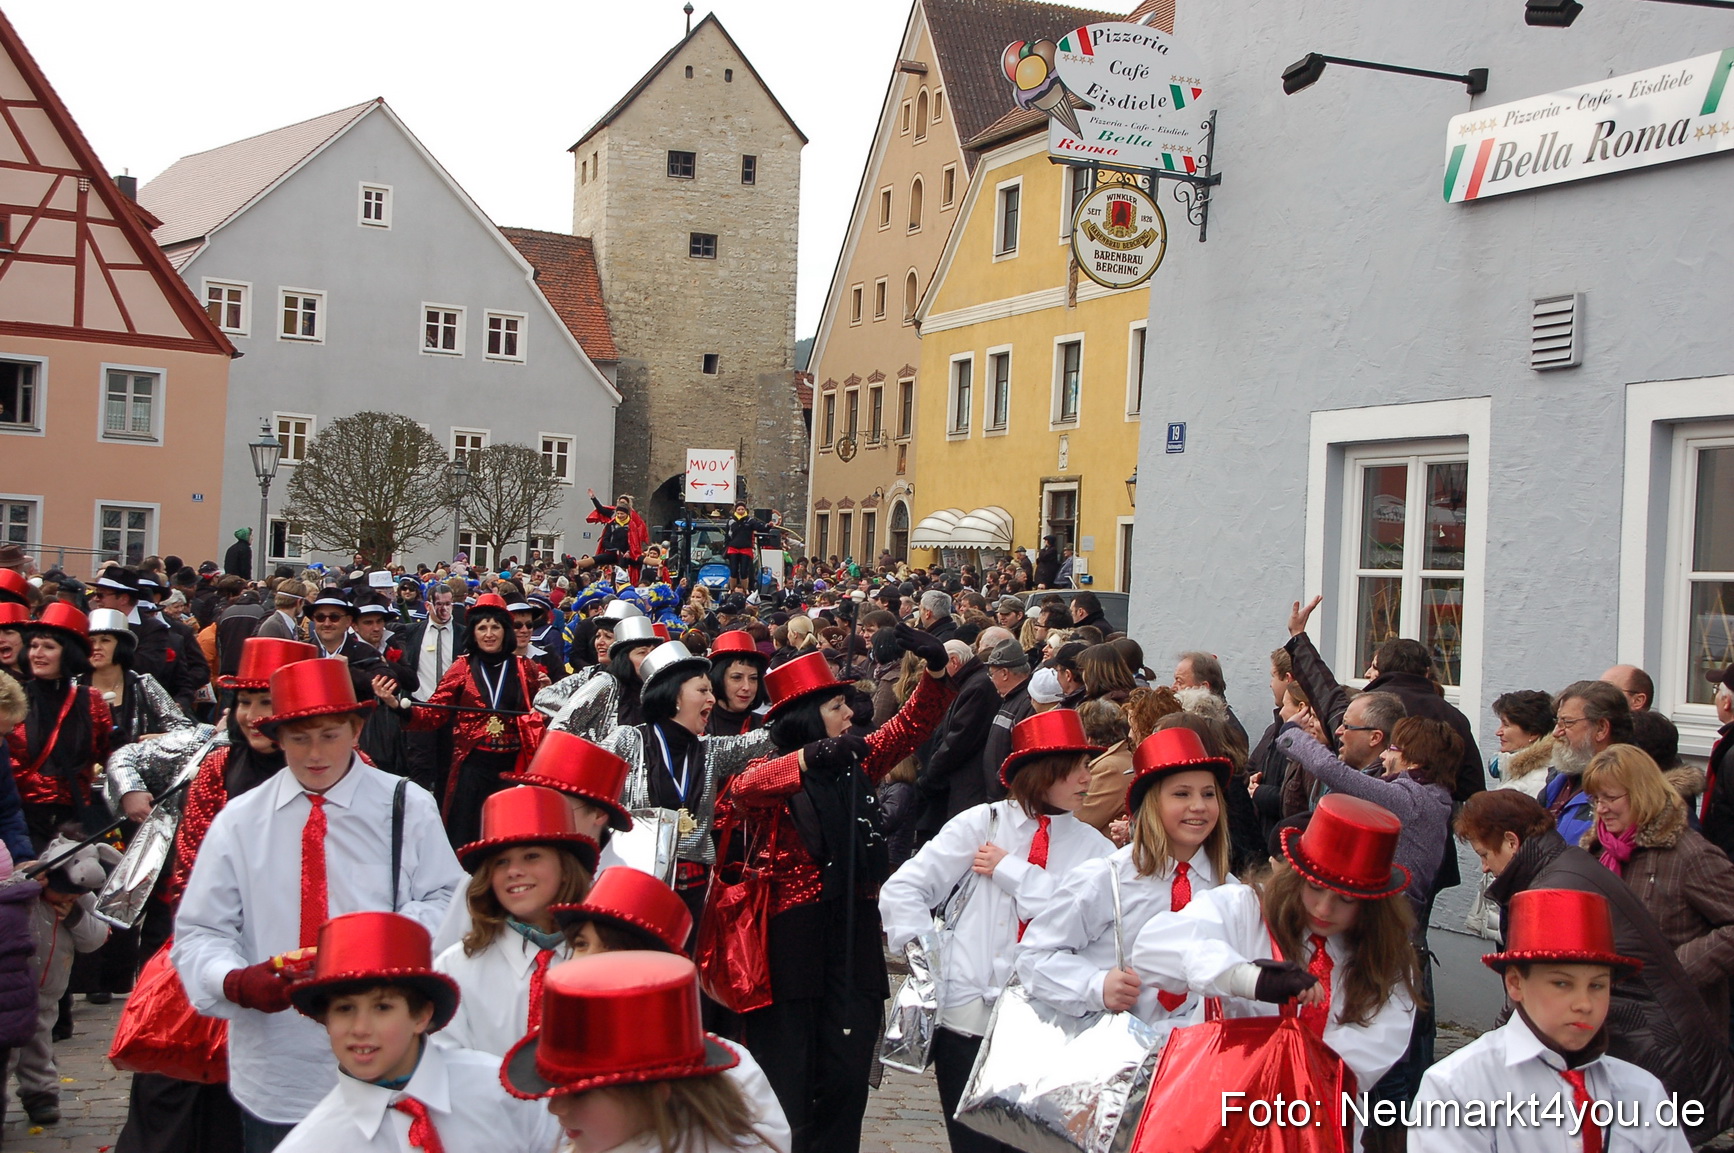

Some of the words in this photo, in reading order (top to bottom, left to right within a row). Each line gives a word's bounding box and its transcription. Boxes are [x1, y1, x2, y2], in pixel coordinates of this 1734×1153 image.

[1092, 28, 1169, 55] Pizzeria
[1109, 59, 1150, 81] Café
[1085, 82, 1168, 110] Eisdiele
[1503, 102, 1561, 128] Pizzeria
[1576, 88, 1612, 112] Café
[1627, 69, 1694, 99] Eisdiele
[1089, 116, 1122, 128] Pizzeria
[1157, 125, 1190, 137] Eisdiele
[1056, 138, 1119, 156] Roma
[1097, 130, 1153, 148] Bella
[1487, 130, 1574, 183] Bella
[1582, 117, 1691, 165] Roma
[1106, 193, 1138, 205] WINKLER
[1087, 207, 1102, 216] SEIT
[1095, 261, 1139, 276] BERCHING
[1171, 425, 1180, 441] 19
